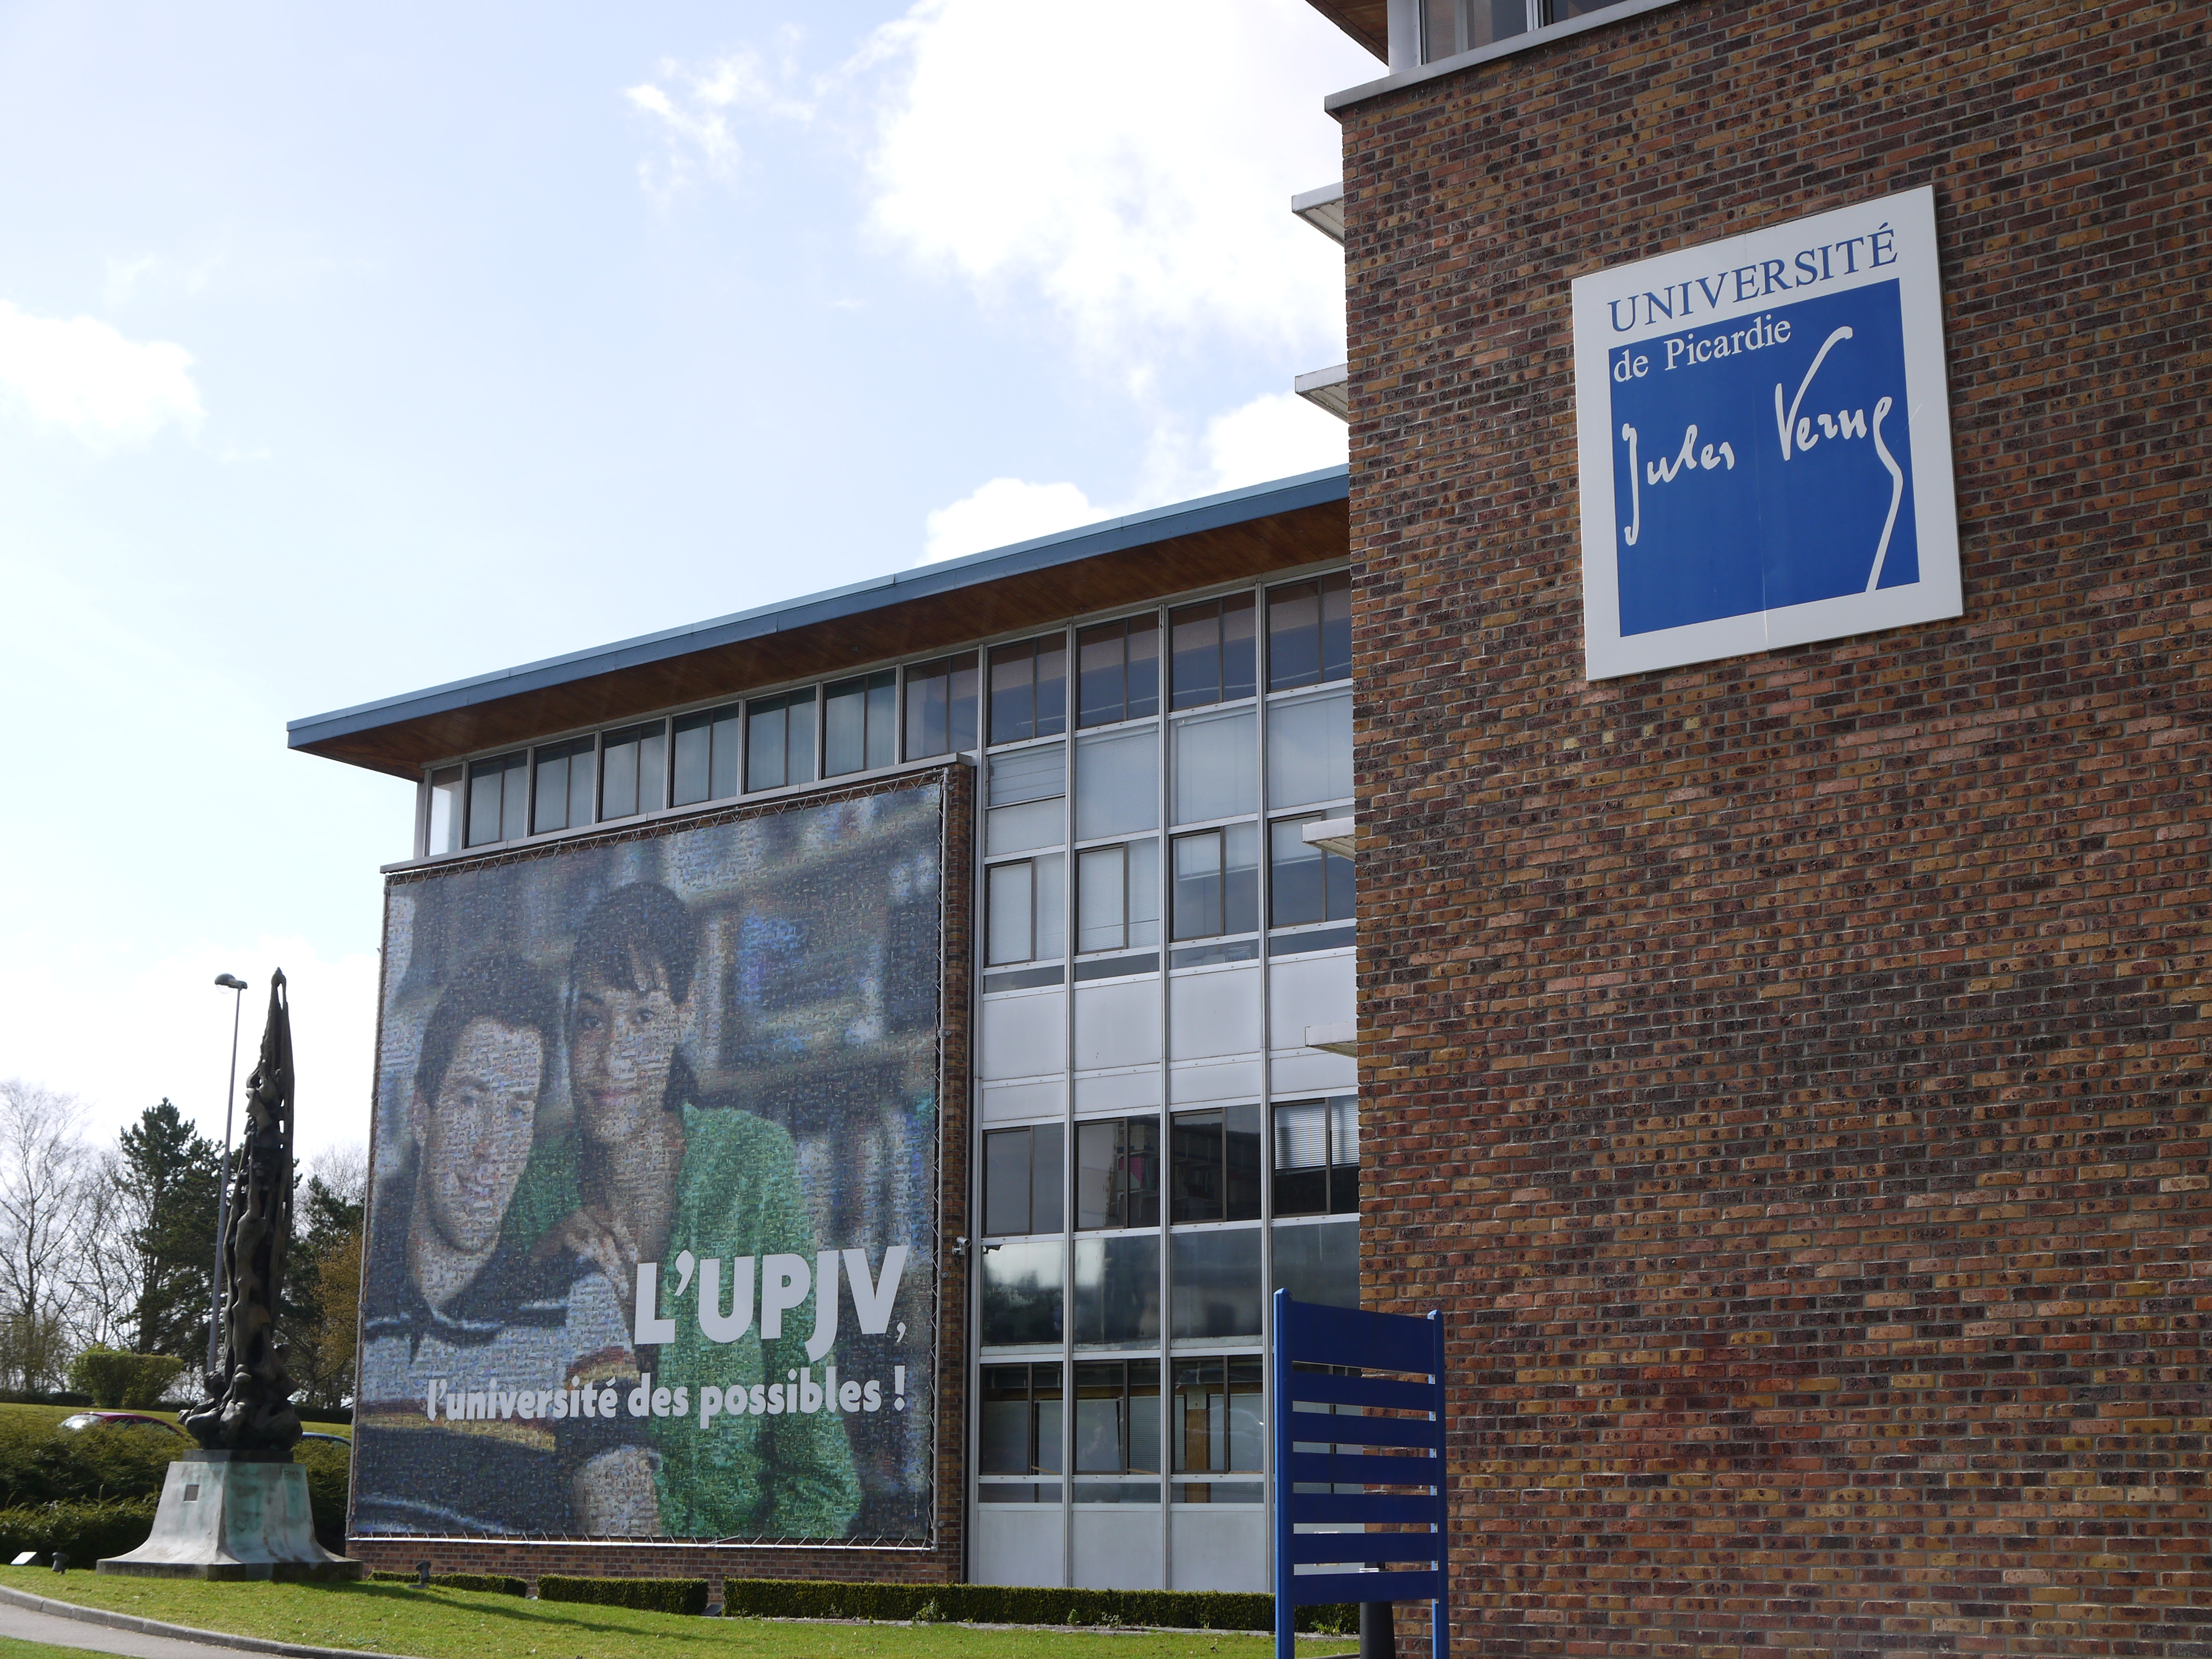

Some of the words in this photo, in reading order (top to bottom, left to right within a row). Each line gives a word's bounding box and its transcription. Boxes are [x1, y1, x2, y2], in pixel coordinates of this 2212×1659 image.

[1608, 222, 1898, 332] UNIVERSITÉ
[1614, 349, 1649, 383] de
[1664, 314, 1791, 371] Picardie
[1622, 422, 1735, 546] Jules
[1775, 326, 1903, 592] Verne
[634, 1244, 909, 1362] L'UPJV,
[427, 1375, 618, 1421] l'université
[628, 1373, 688, 1417] des
[700, 1366, 881, 1429] possibles
[894, 1365, 905, 1411] !
